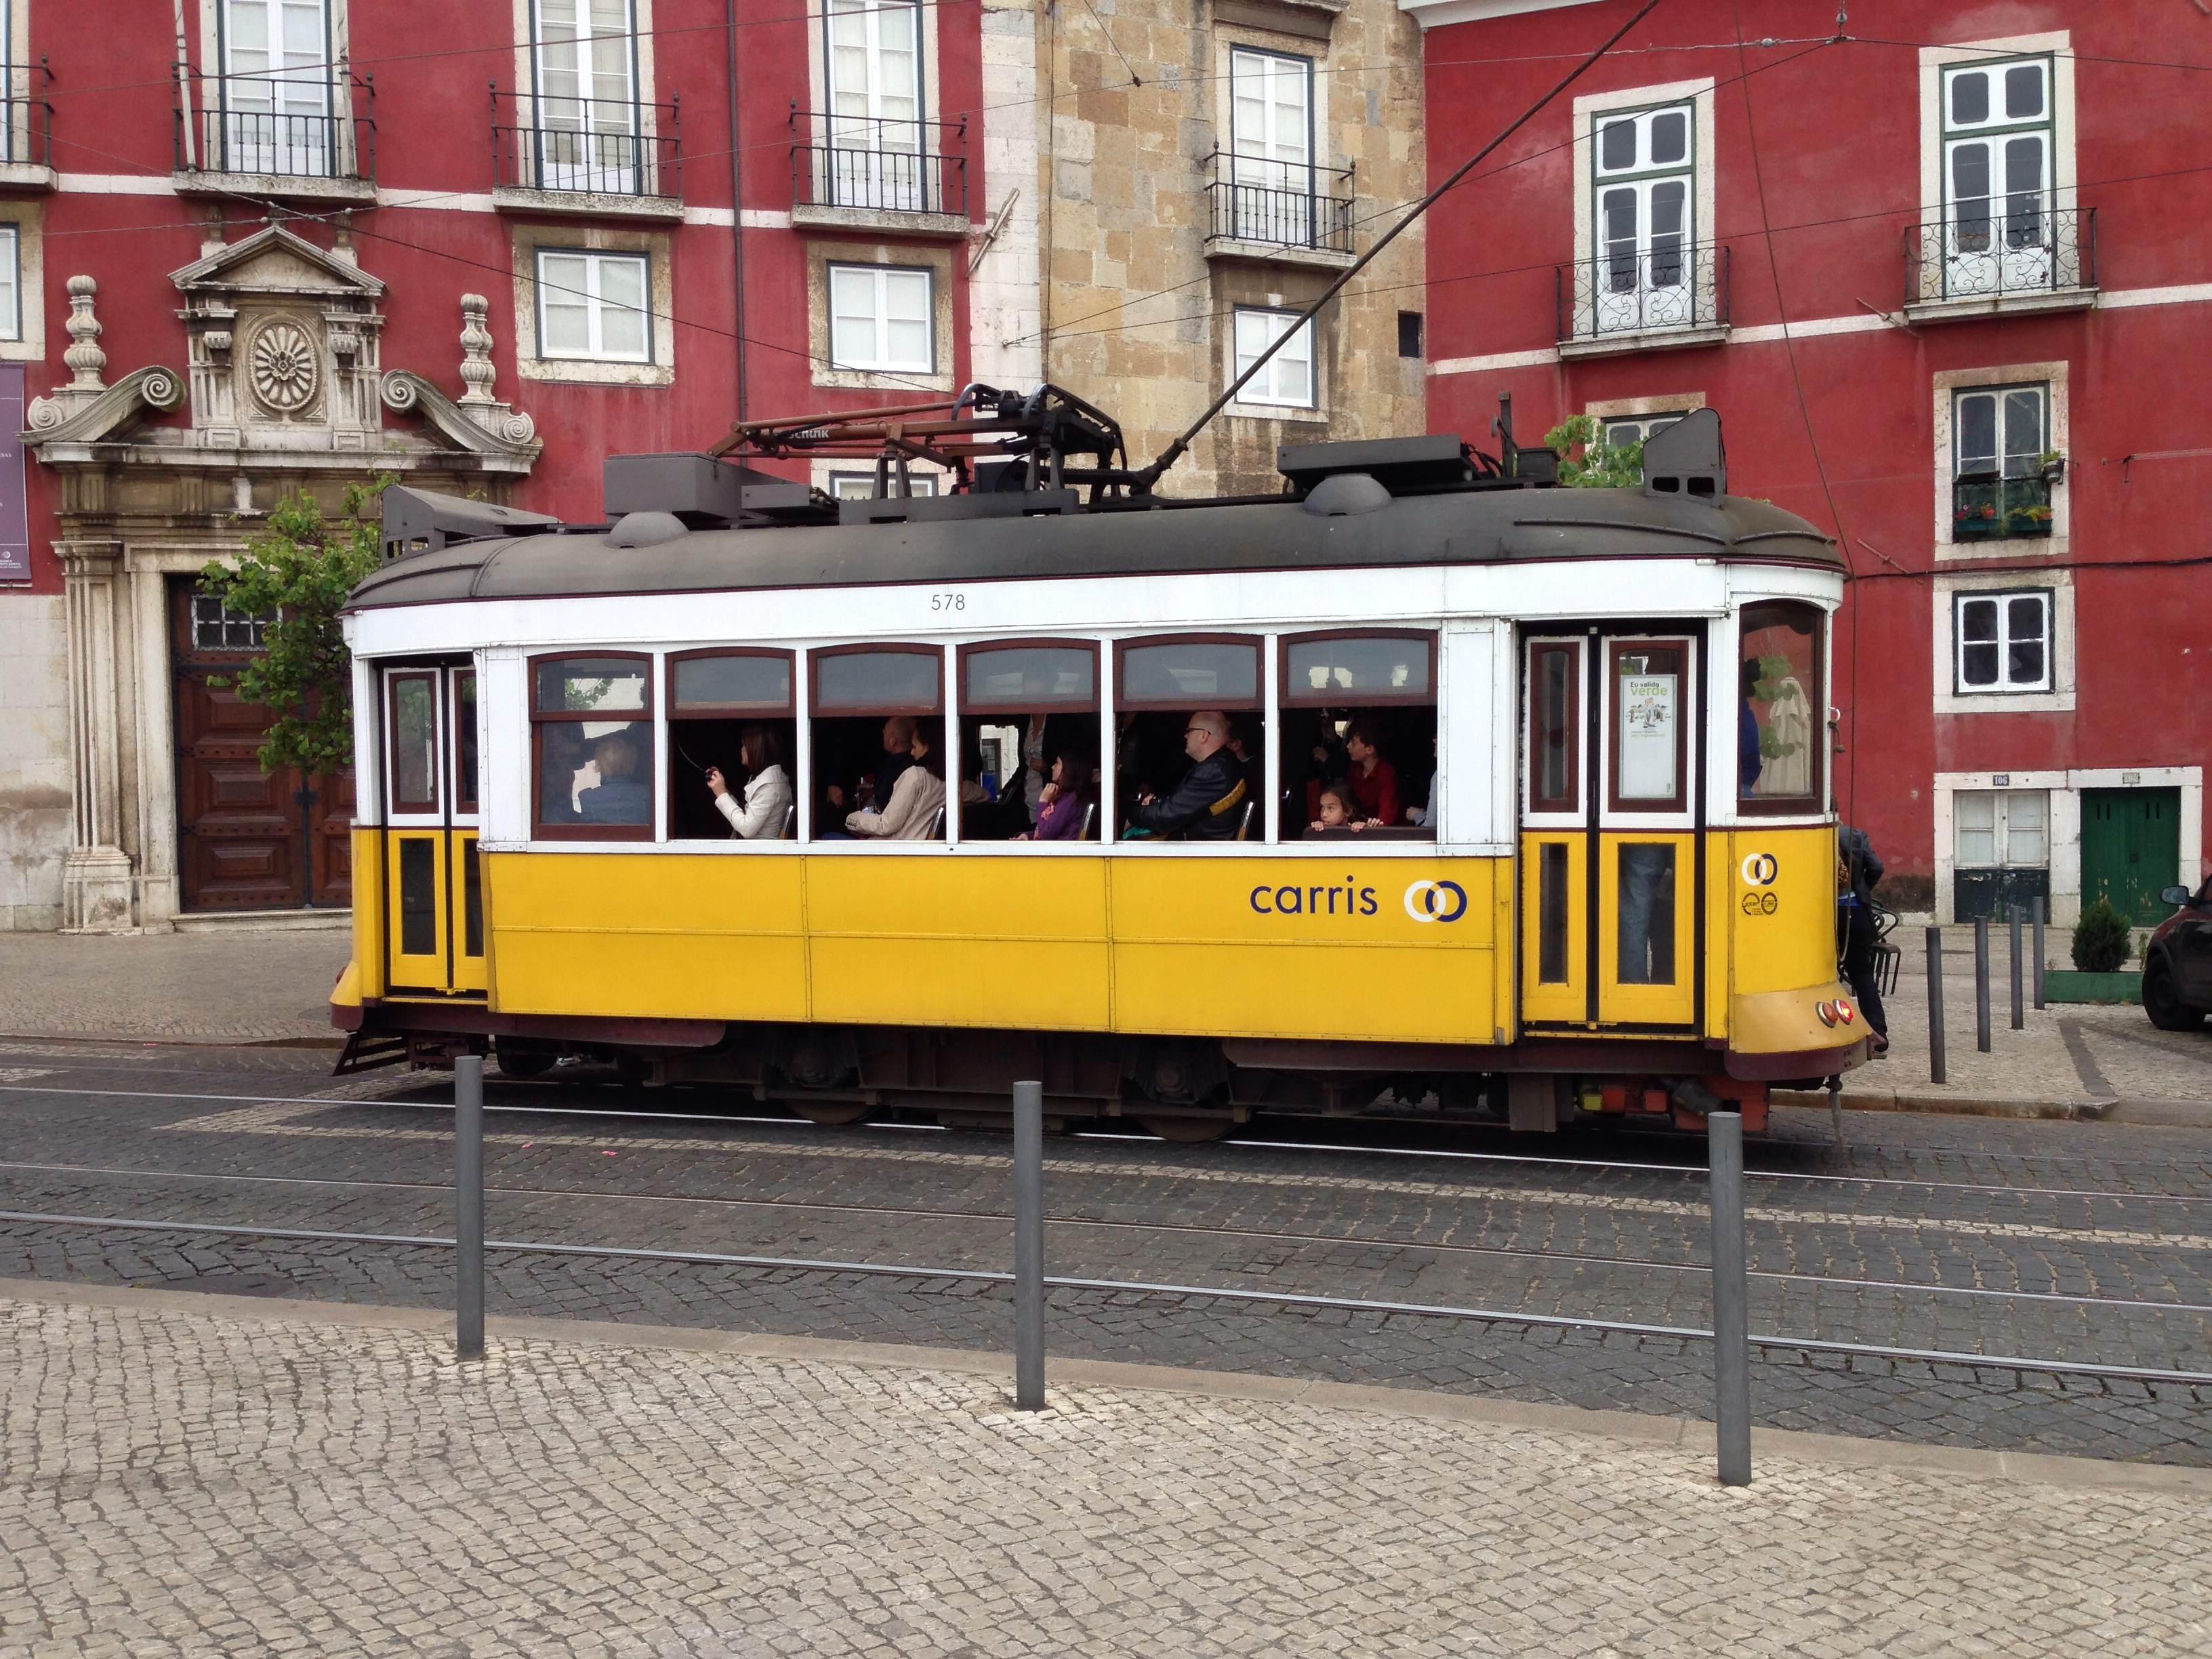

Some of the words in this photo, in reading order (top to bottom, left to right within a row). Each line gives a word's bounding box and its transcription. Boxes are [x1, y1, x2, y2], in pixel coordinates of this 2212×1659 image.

[931, 594, 965, 611] 578
[1631, 687, 1668, 695] verde
[1250, 875, 1378, 916] carris
